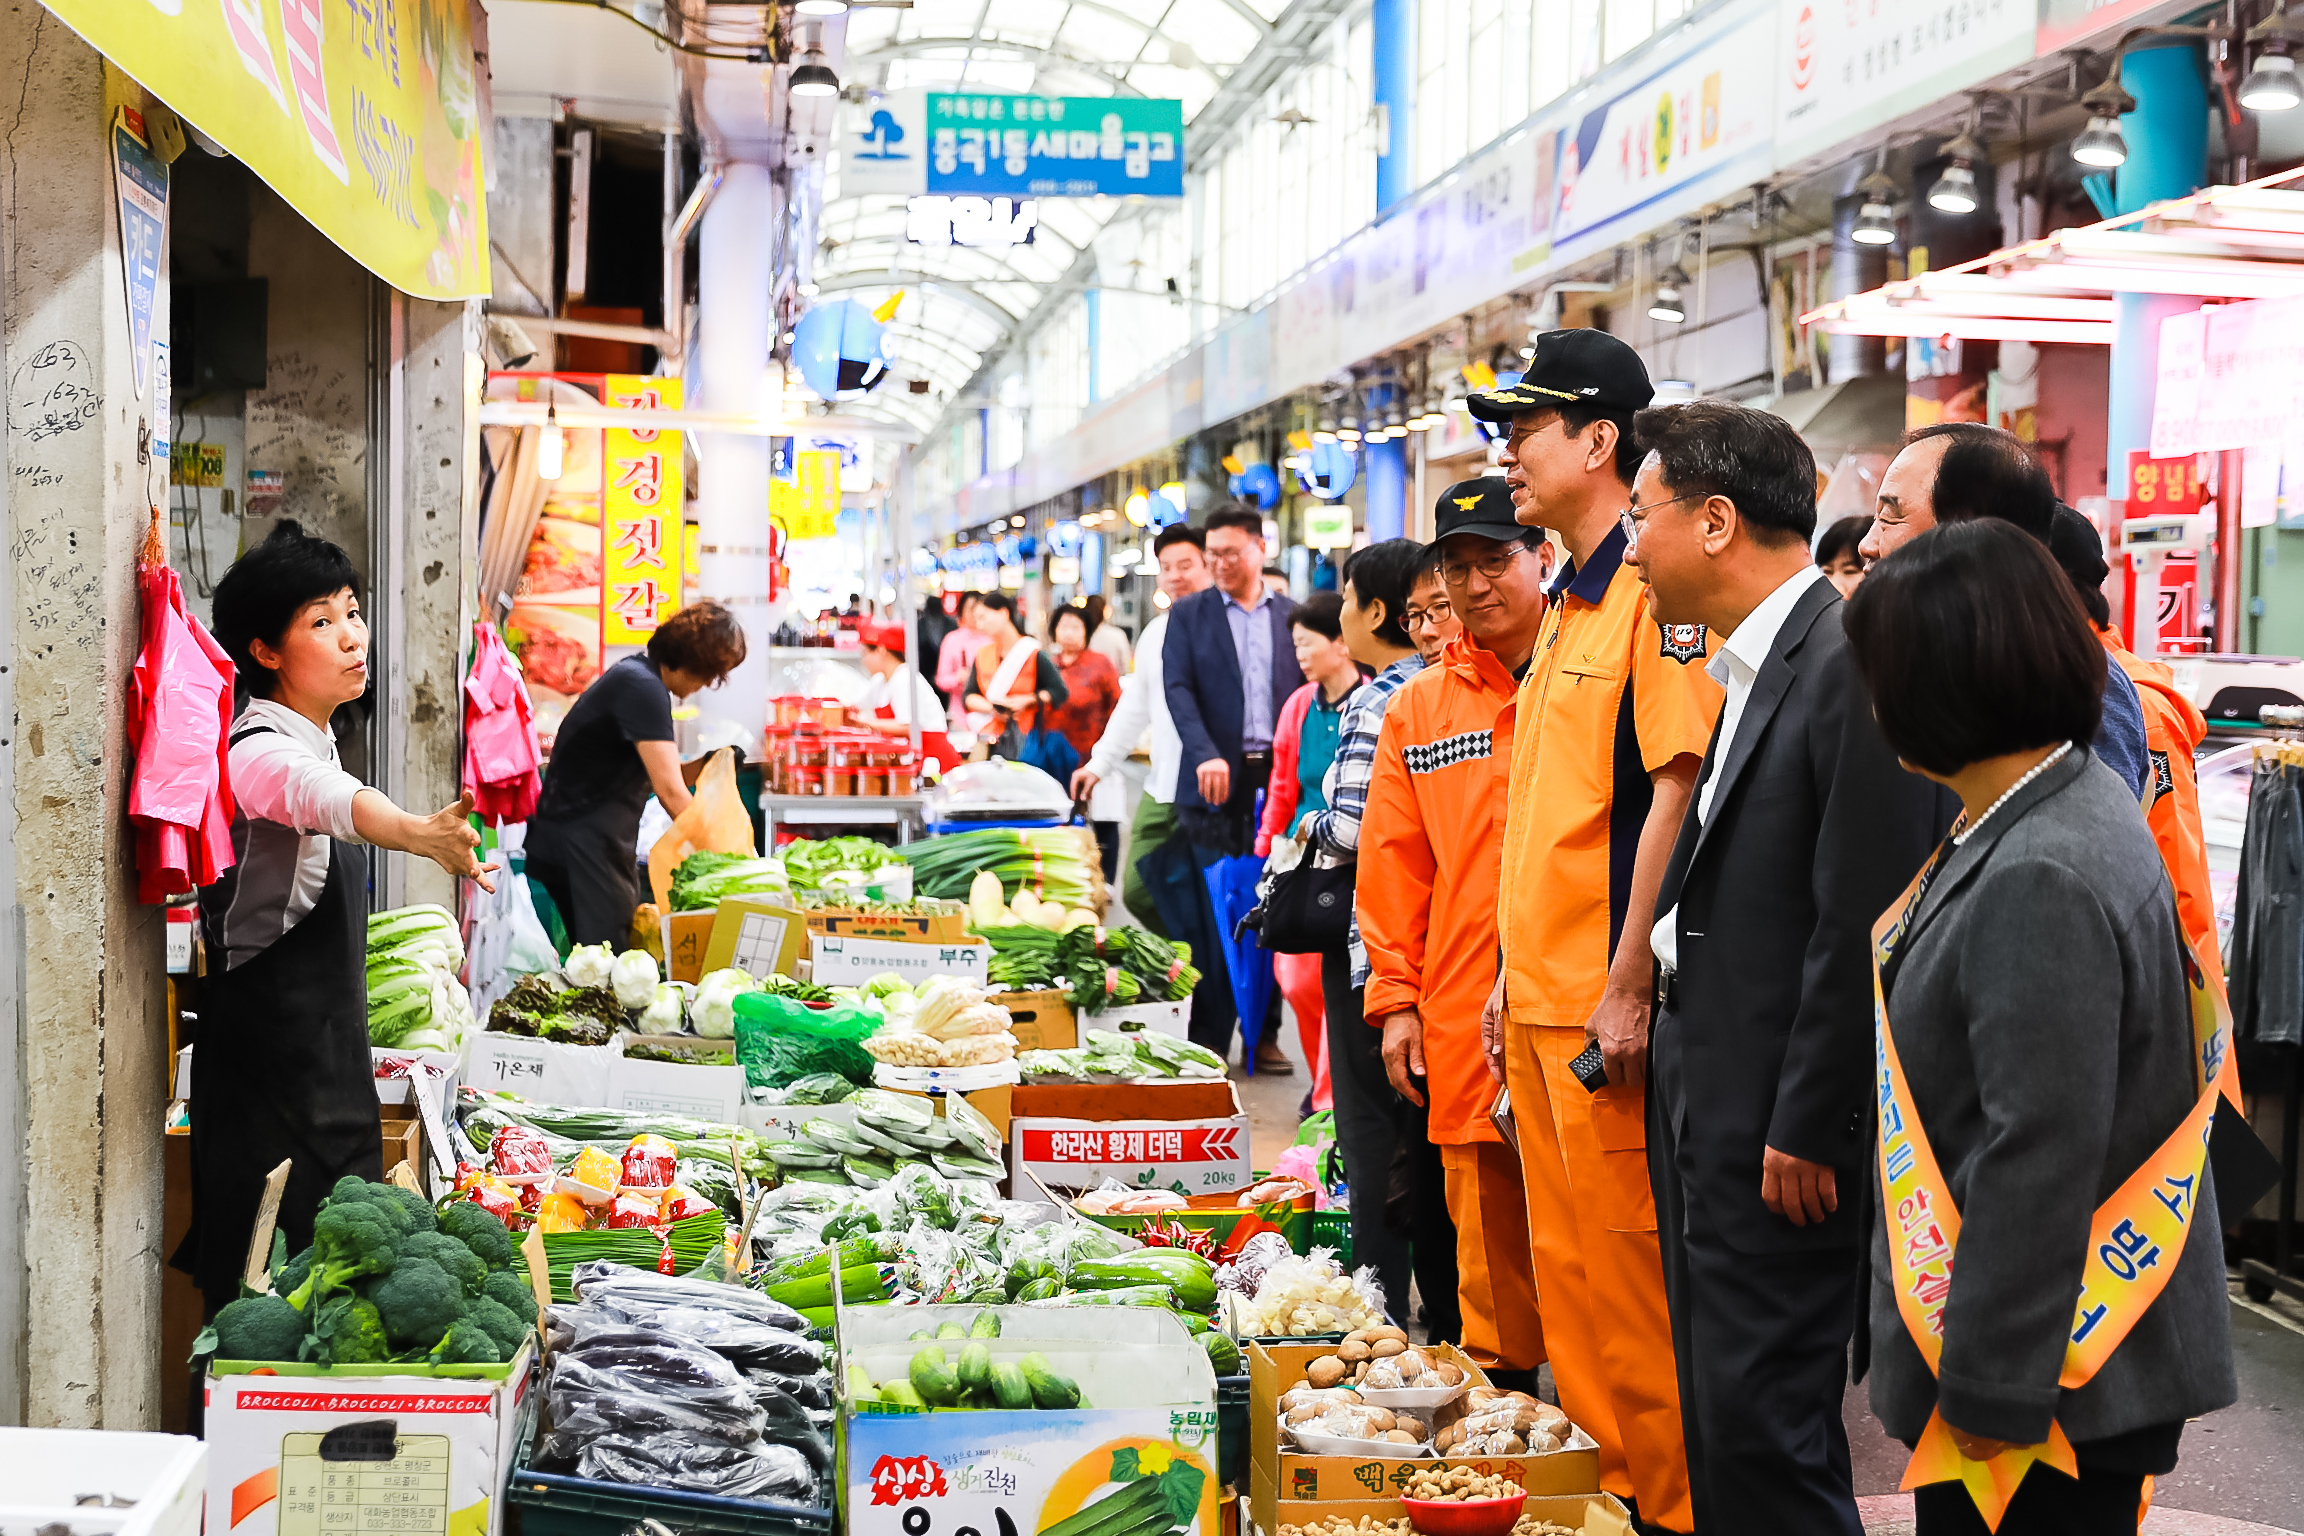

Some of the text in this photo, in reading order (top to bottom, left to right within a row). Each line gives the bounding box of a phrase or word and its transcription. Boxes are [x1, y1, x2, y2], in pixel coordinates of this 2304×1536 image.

[131, 213, 155, 279] 카드
[1051, 1131, 1182, 1161] 한라산 황제 더덕
[1203, 1171, 1236, 1186] 20kg
[240, 1395, 490, 1411] BROCCOLI BROCCOLI BROCCOLI
[383, 1475, 420, 1487] 브로콜리
[878, 1461, 936, 1496] 싱싱
[951, 1464, 1016, 1497] 생거진천
[382, 1491, 420, 1503] 상단표시
[288, 1502, 315, 1514] 규격품
[363, 1507, 437, 1519] 대화농업협동조합
[326, 1511, 353, 1523] 생산자
[367, 1518, 433, 1529] 033-333-2723
